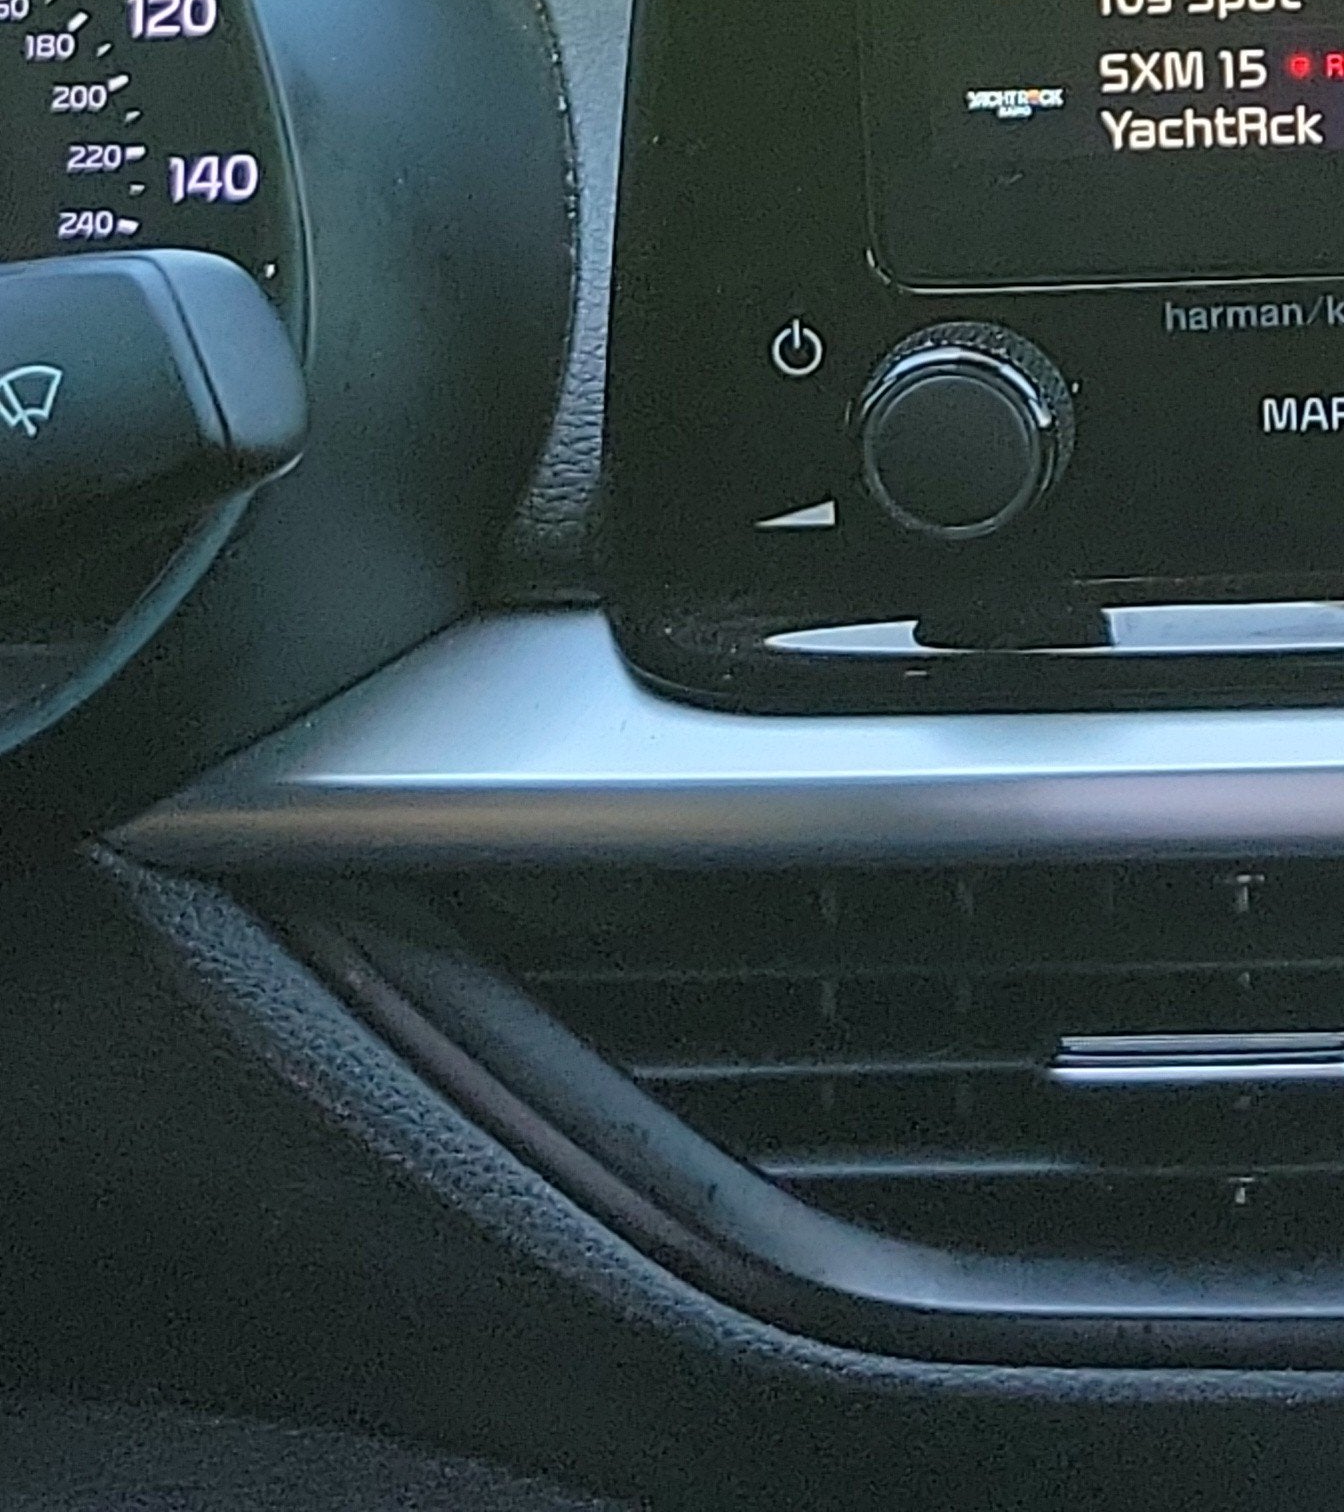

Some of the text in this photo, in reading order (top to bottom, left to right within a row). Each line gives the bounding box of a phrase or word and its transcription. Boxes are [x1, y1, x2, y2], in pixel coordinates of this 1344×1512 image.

[25, 33, 76, 60] 180
[1100, 51, 1204, 93] SXM
[1219, 49, 1267, 89] 15
[51, 86, 108, 111] 200
[1101, 105, 1323, 150] YachtRck
[67, 144, 122, 170] 220
[170, 154, 258, 202] 140
[58, 210, 114, 236] 240
